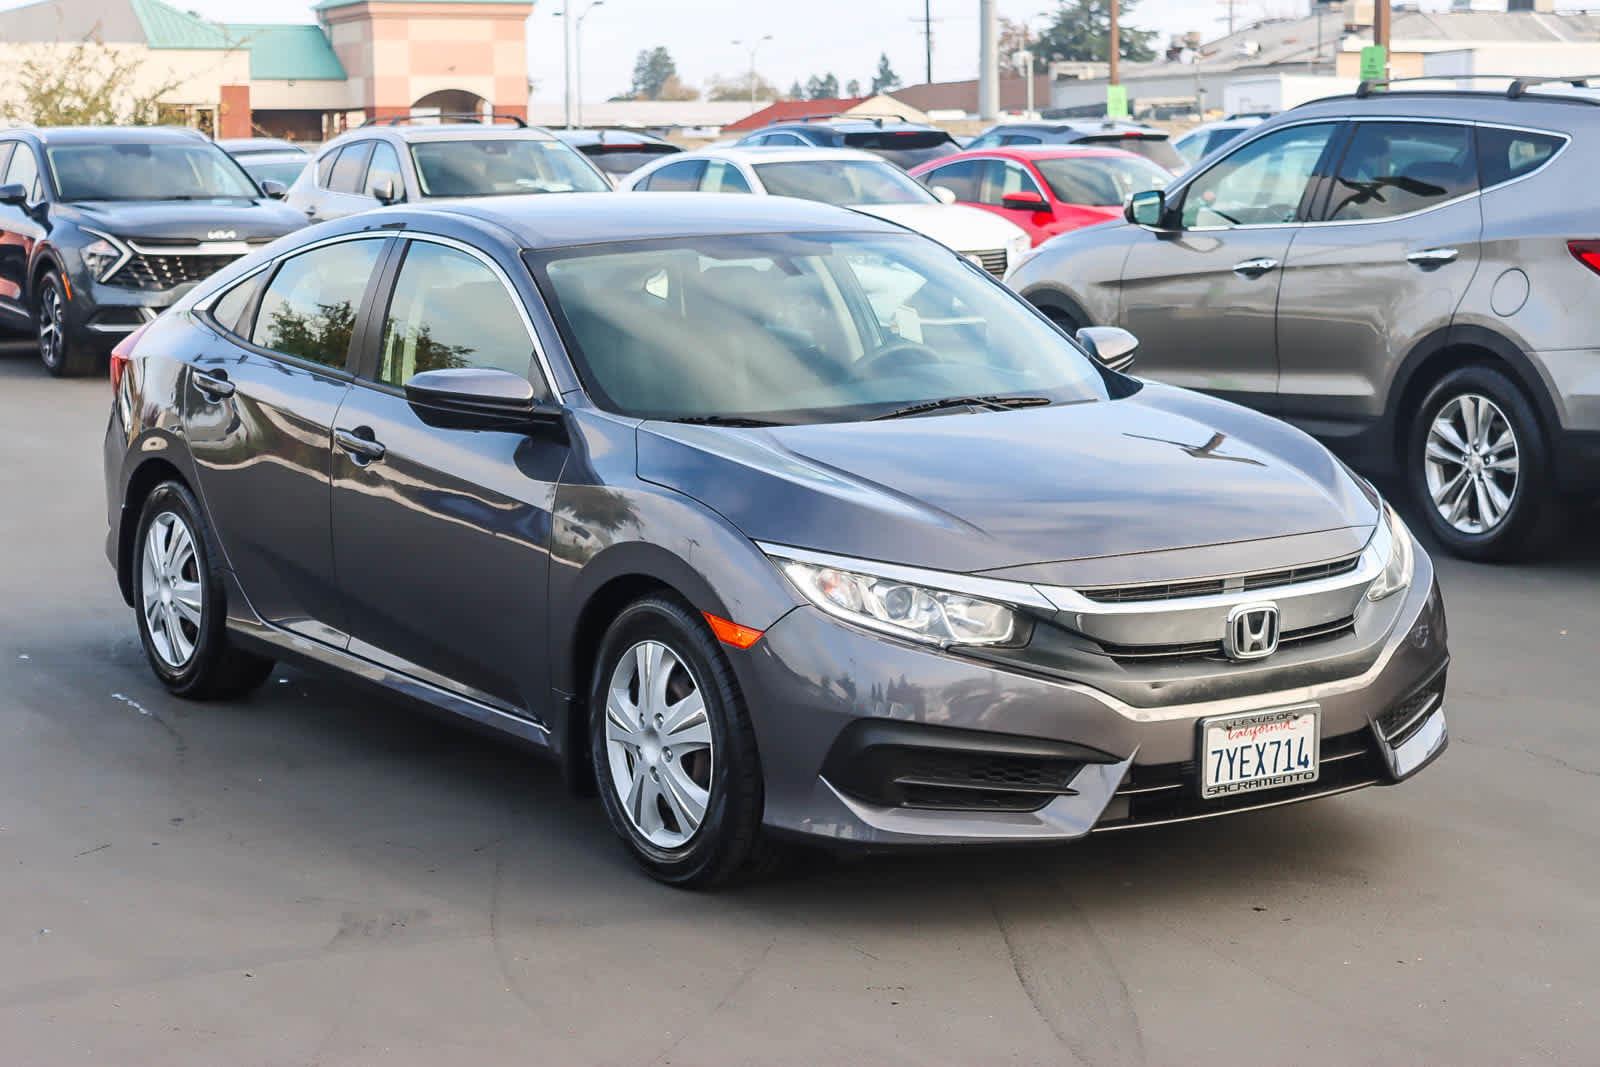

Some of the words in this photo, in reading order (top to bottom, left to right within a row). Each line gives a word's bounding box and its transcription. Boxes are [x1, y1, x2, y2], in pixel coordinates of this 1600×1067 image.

[1227, 720, 1296, 741] California
[1233, 714, 1274, 727] LEXUS
[1276, 712, 1293, 721] OF
[1211, 736, 1310, 783] 7YEX714
[1207, 771, 1315, 796] SACRAMENTO
